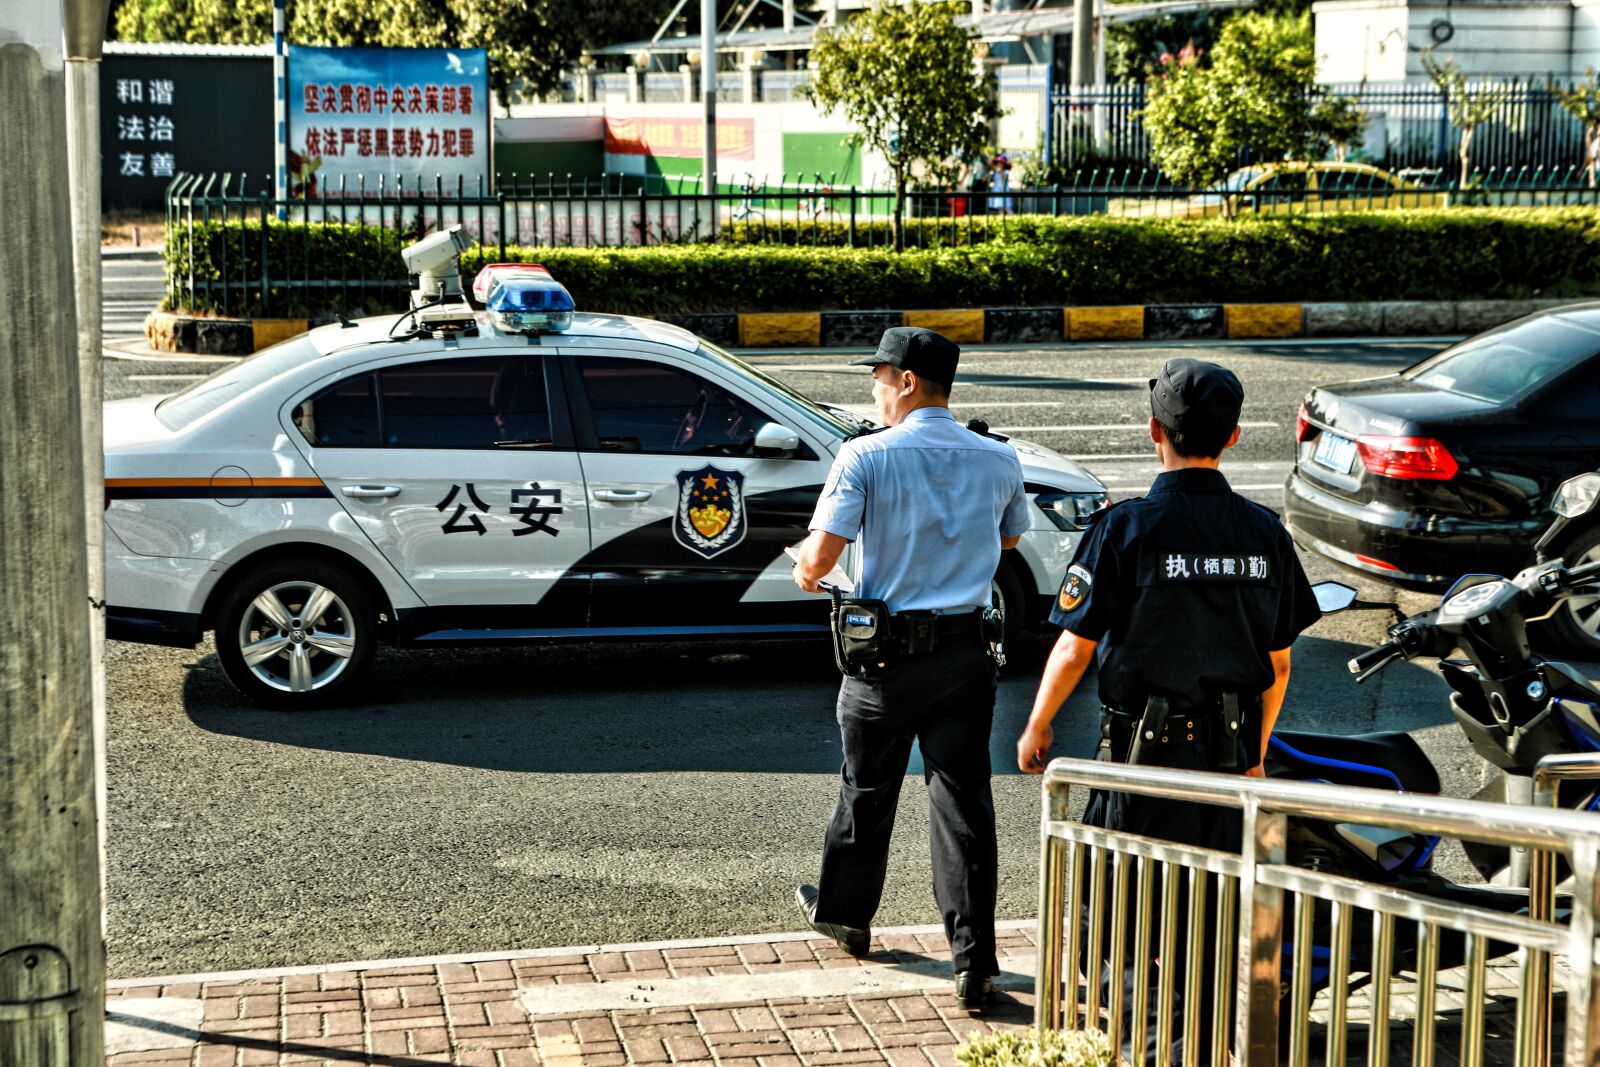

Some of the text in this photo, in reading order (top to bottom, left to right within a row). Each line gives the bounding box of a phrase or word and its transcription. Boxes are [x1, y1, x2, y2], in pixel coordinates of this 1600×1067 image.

[116, 79, 175, 105] 和谐
[304, 84, 473, 115] 坚决贯彻中央决策部署
[118, 115, 175, 141] 法治
[305, 127, 474, 157] 依法严惩黑恶势力犯罪
[119, 151, 176, 177] 友善
[435, 481, 563, 537] 公安
